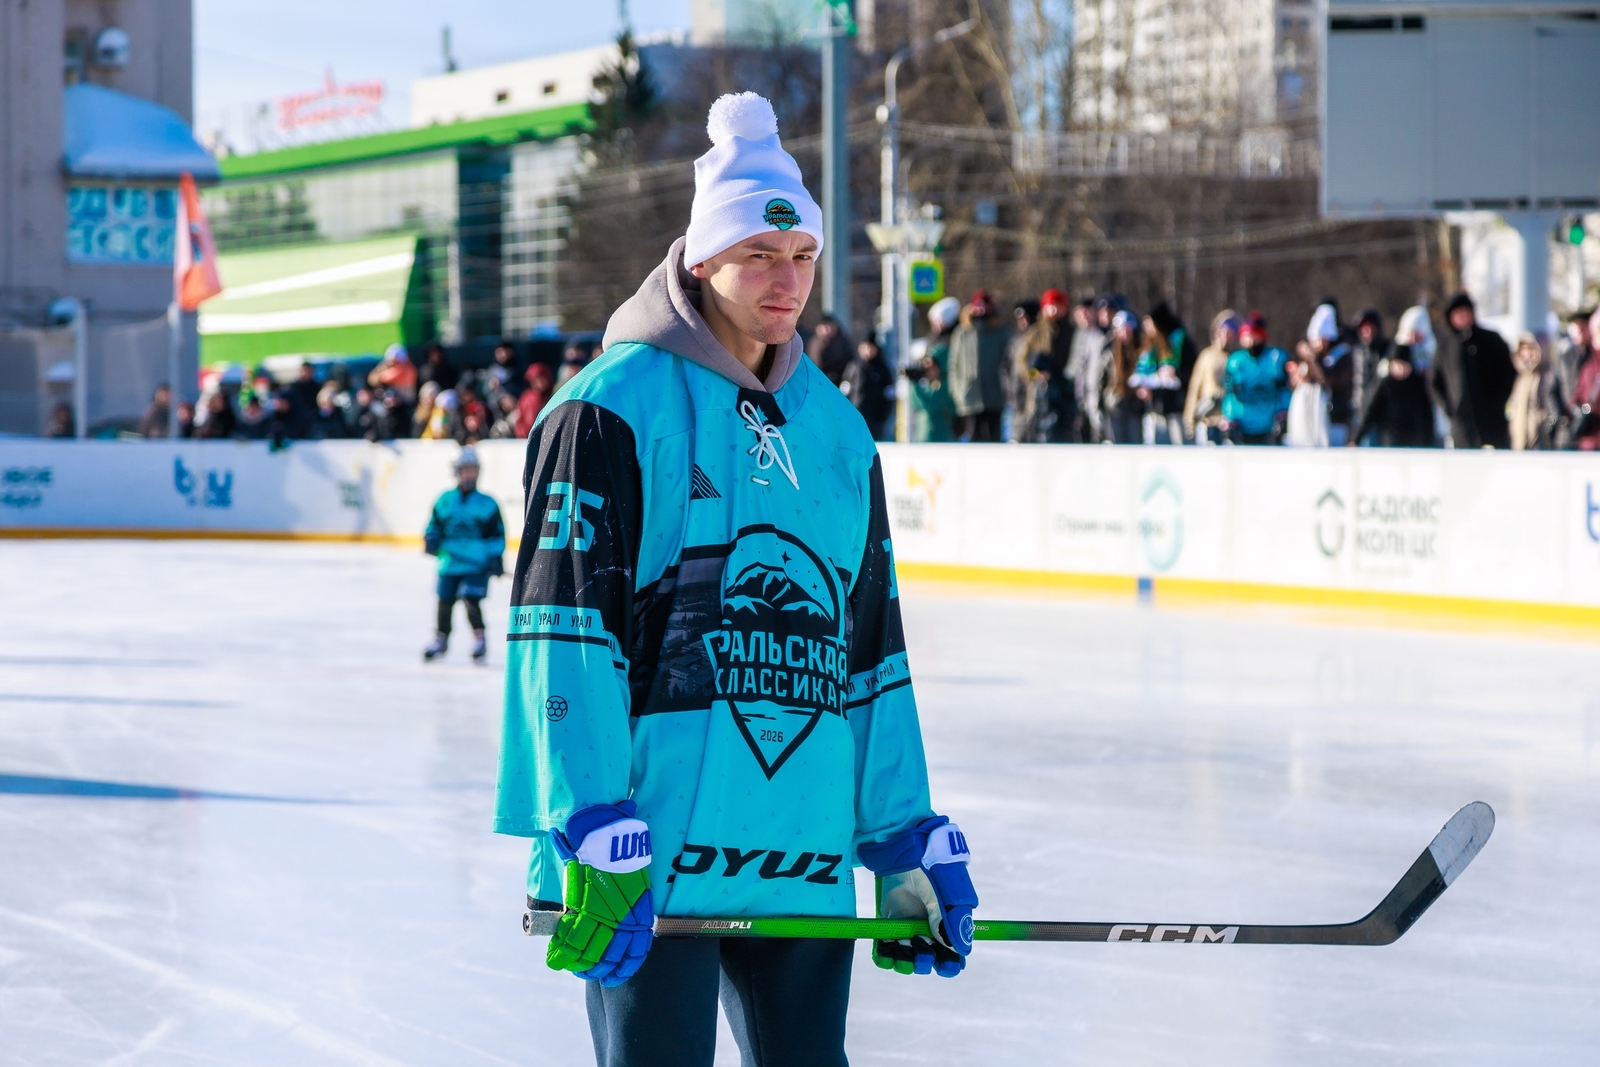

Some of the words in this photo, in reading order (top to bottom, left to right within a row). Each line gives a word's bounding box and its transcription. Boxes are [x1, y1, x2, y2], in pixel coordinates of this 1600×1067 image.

[539, 481, 604, 552] 35
[514, 613, 531, 626] УРАЛ
[539, 613, 560, 626] УРАЛ
[571, 614, 592, 629] УРАЛ
[715, 630, 847, 687] РАЛЬСКАЯ
[760, 729, 784, 743] 2026
[666, 843, 844, 885] OYUZ
[1107, 924, 1240, 944] CCM
